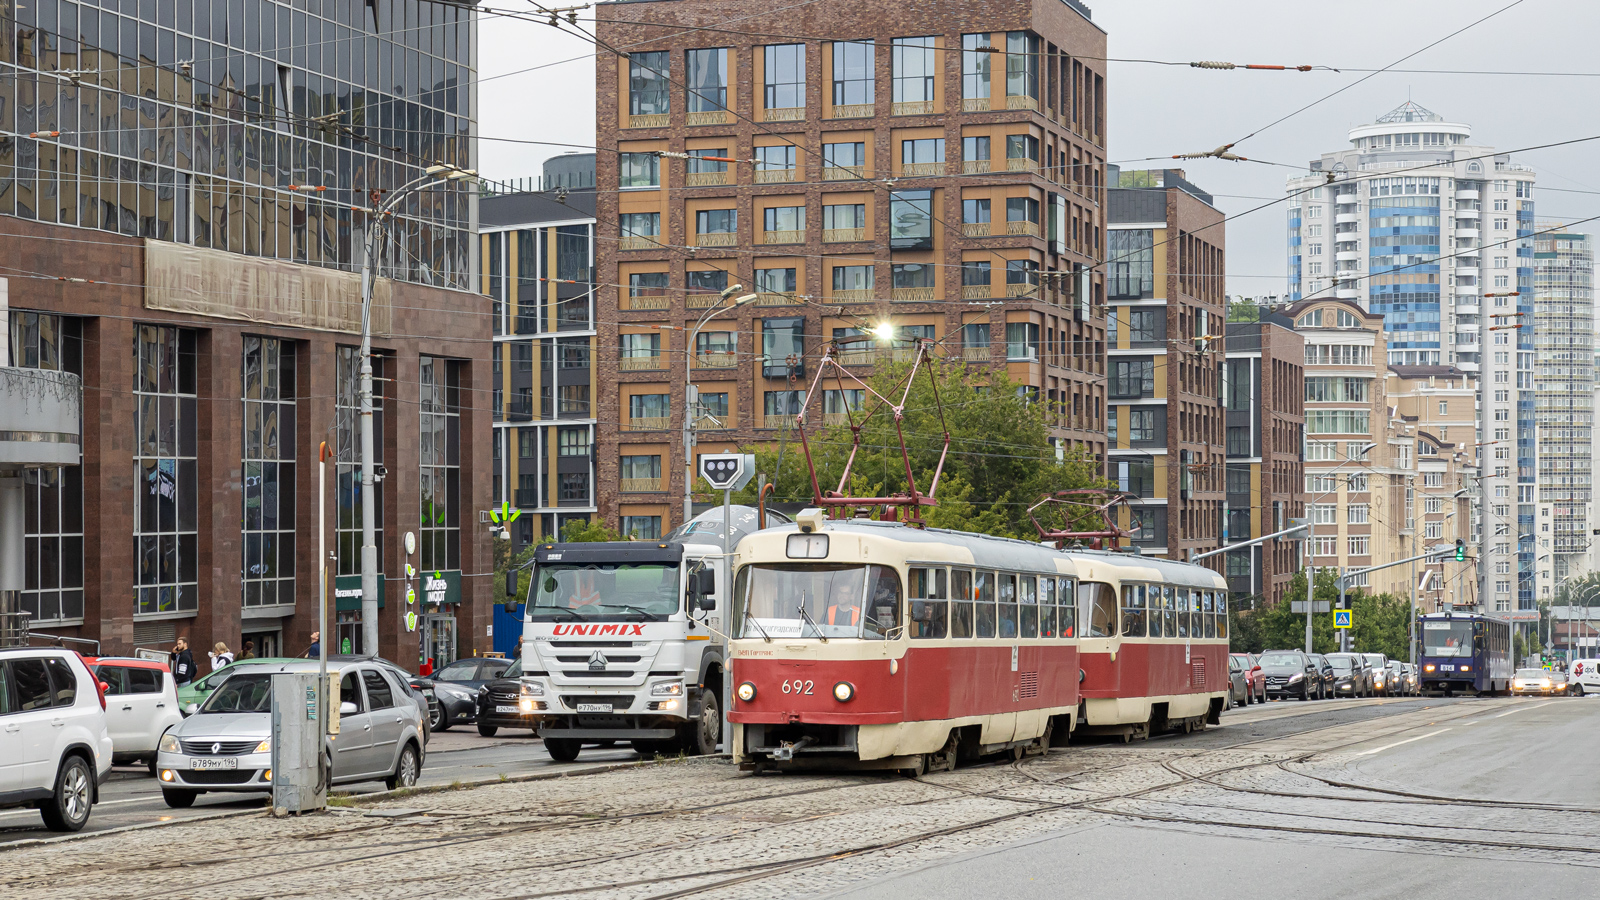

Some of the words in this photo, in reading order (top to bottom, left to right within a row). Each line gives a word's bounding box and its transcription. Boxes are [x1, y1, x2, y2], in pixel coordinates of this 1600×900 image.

[806, 538, 811, 558] 1
[553, 624, 647, 636] UNIMIX
[1585, 666, 1595, 674] dpd
[782, 679, 814, 695] 692
